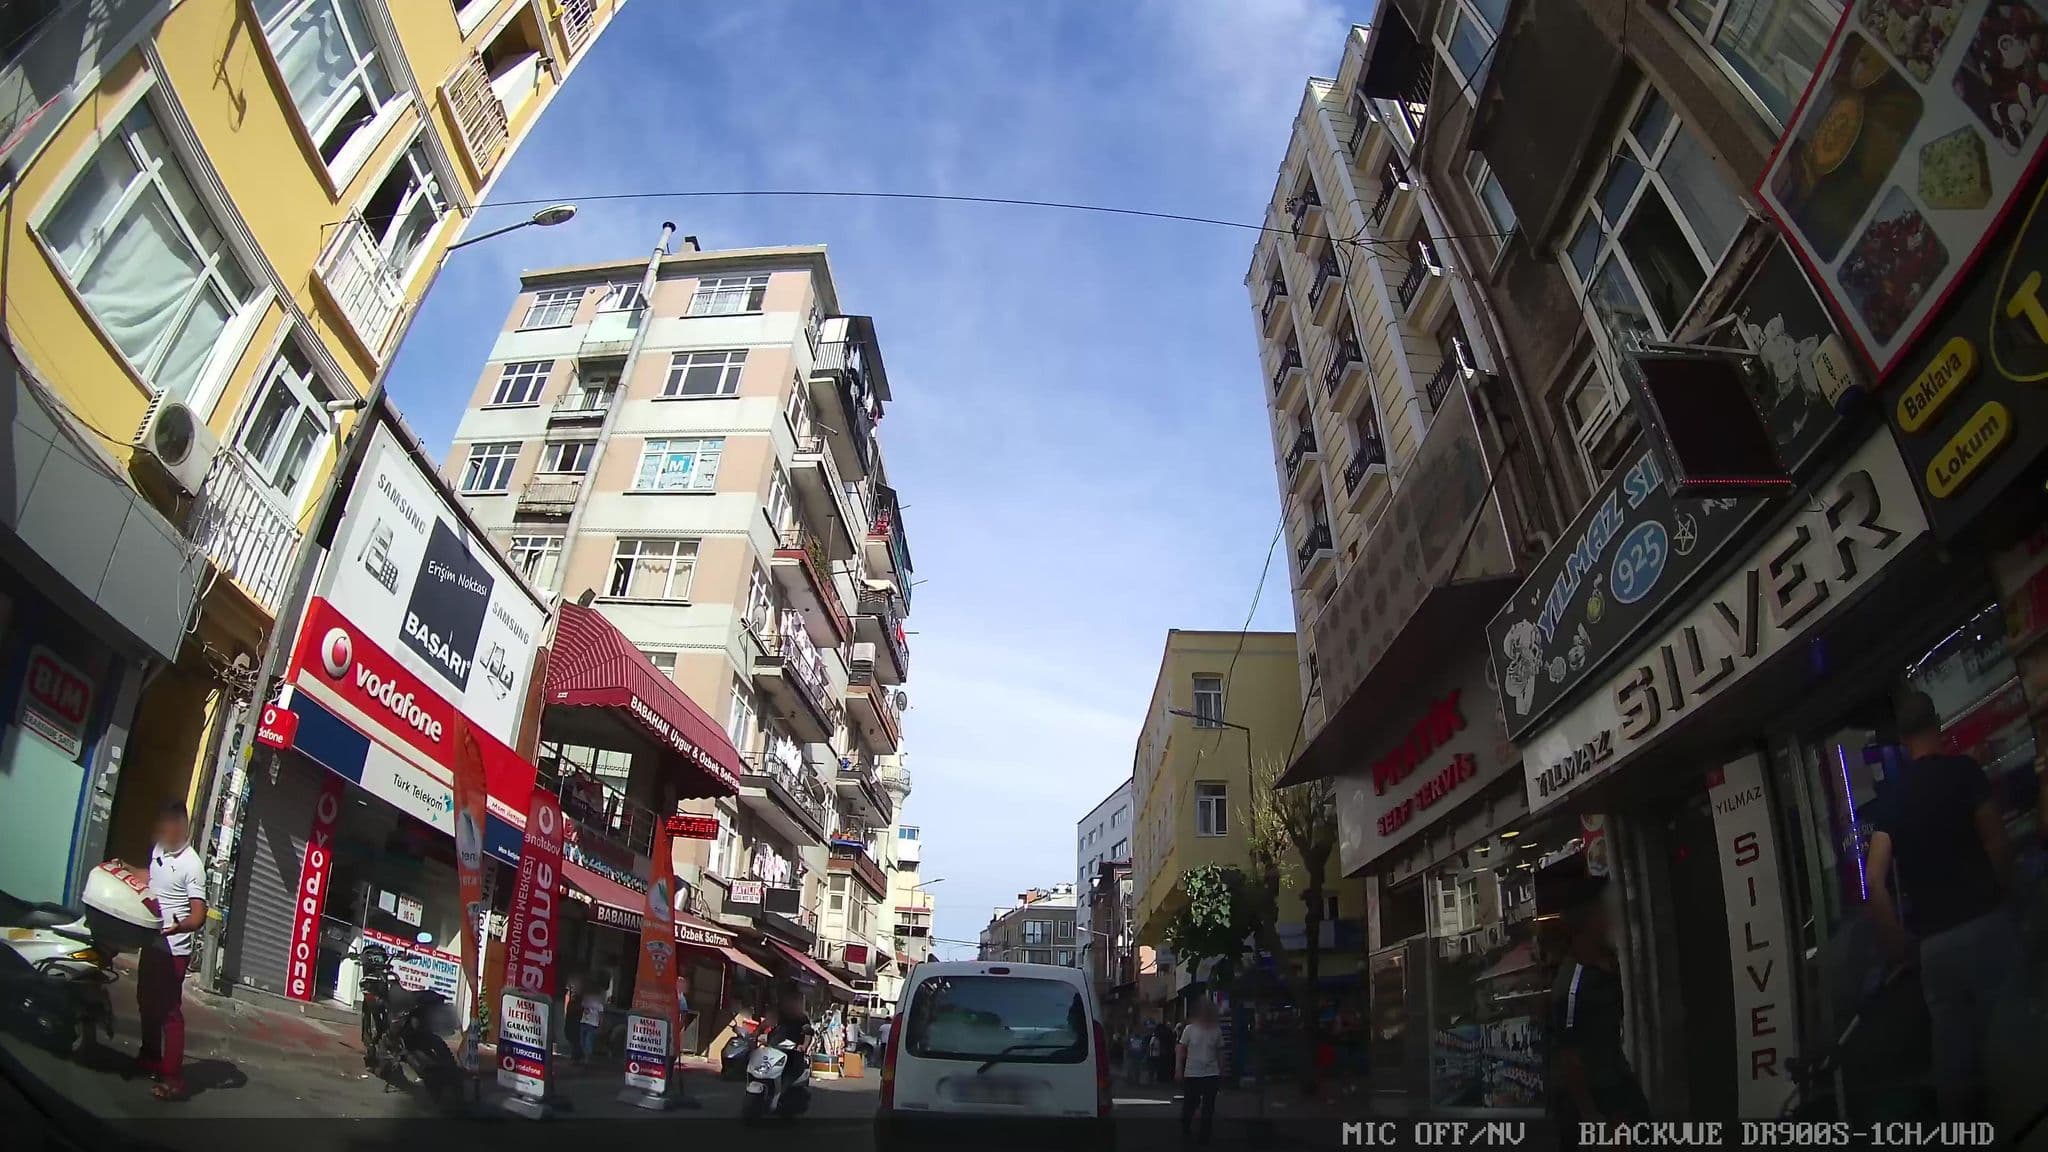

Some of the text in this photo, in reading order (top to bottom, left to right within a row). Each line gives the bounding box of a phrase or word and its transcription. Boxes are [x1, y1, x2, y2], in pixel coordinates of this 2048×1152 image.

[1902, 350, 1963, 421] Baklava
[1935, 415, 2000, 487] Lokum
[377, 474, 426, 535] SAMSUNG
[428, 560, 488, 596] Erişim Noktası
[1617, 527, 1661, 594] 925
[492, 601, 530, 645] SAMSUNG
[1613, 470, 1902, 741] SILVER
[405, 611, 470, 679] BAŞARI
[355, 662, 443, 742] vodafone
[630, 695, 670, 738] BABAHAN
[669, 730, 692, 755] Uygur
[692, 745, 700, 758] &
[699, 748, 719, 774] Özbek
[1533, 729, 1614, 799] YILMAZ
[393, 773, 443, 812] Türk Telekom
[1714, 786, 1763, 816] YILMAZ
[292, 829, 329, 996] vodafone
[597, 906, 643, 930] BABAHAN
[680, 925, 703, 943] Özbek
[1733, 831, 1779, 1081] SILVER
[506, 1021, 542, 1037] GARANTİLİ
[515, 1000, 536, 1012] MSM
[639, 1018, 656, 1028] MSM
[512, 1046, 543, 1061] TURKCELL
